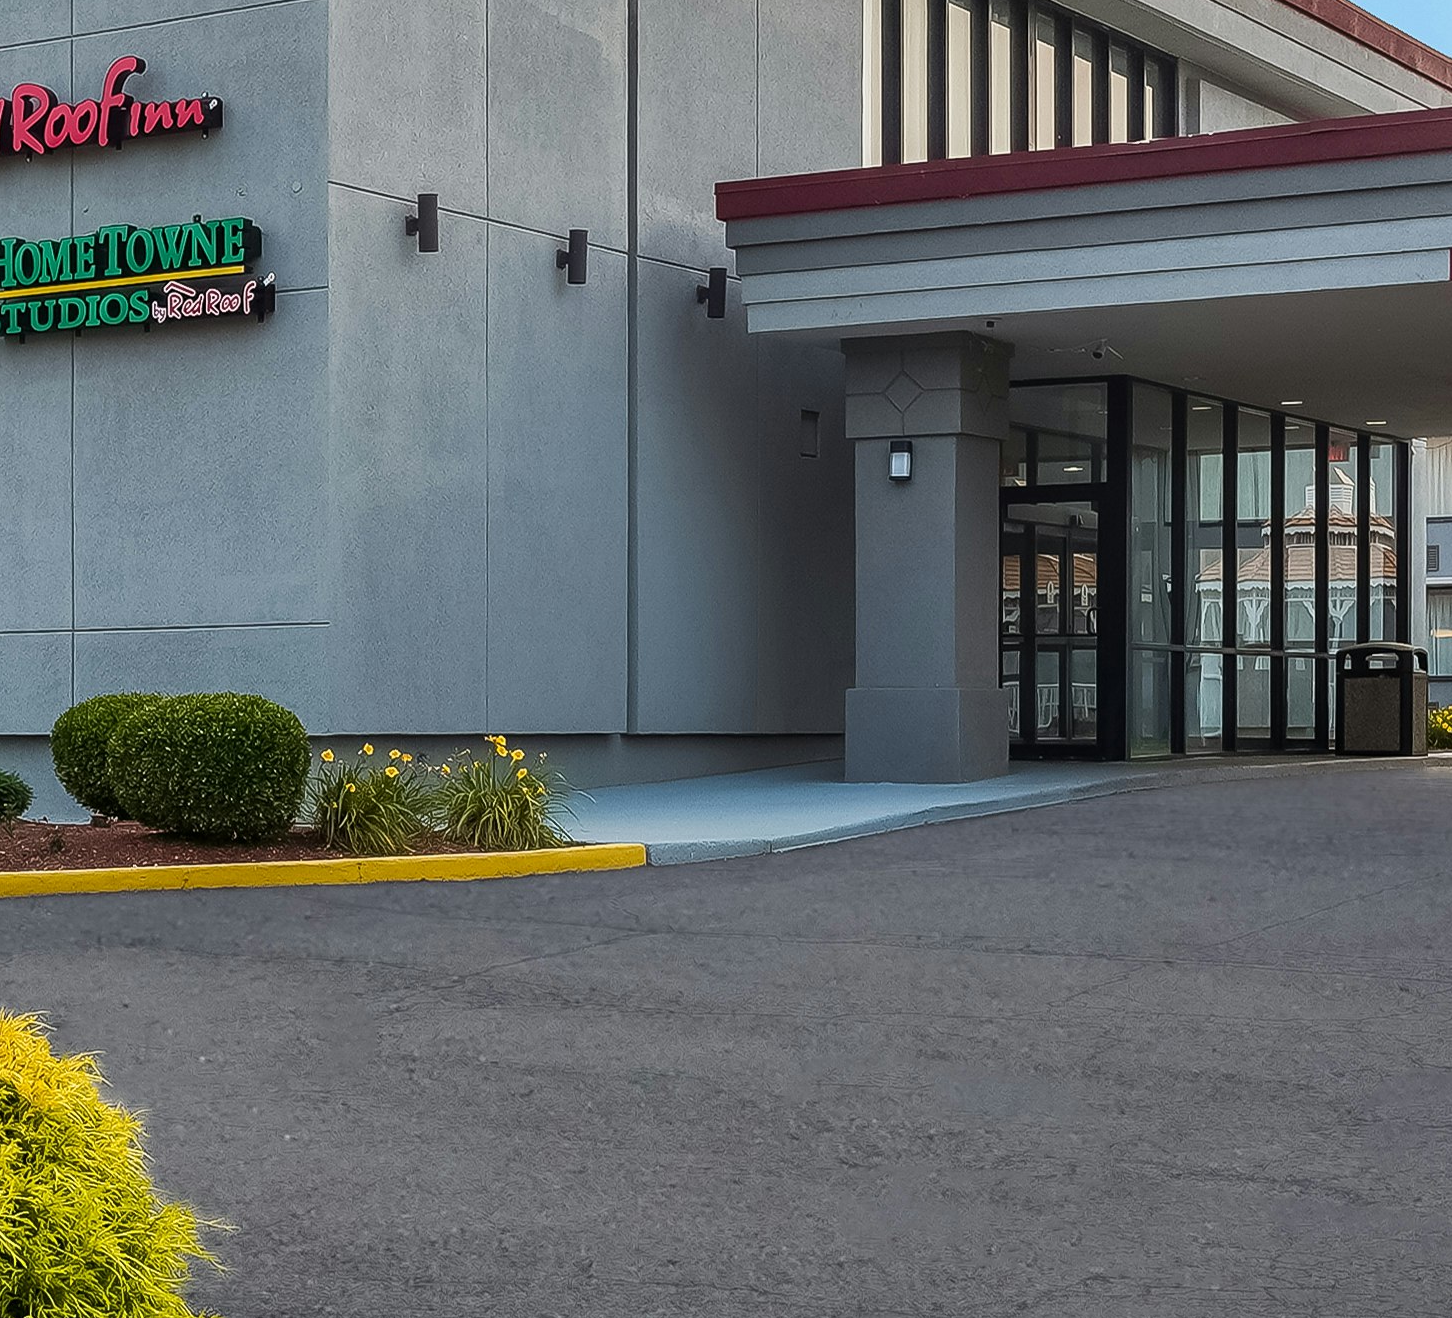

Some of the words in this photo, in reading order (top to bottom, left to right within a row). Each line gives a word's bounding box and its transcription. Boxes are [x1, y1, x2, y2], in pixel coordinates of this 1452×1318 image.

[11, 56, 137, 154] Roof
[152, 301, 167, 324] by
[167, 292, 204, 319] Red
[205, 280, 257, 316] Roof
